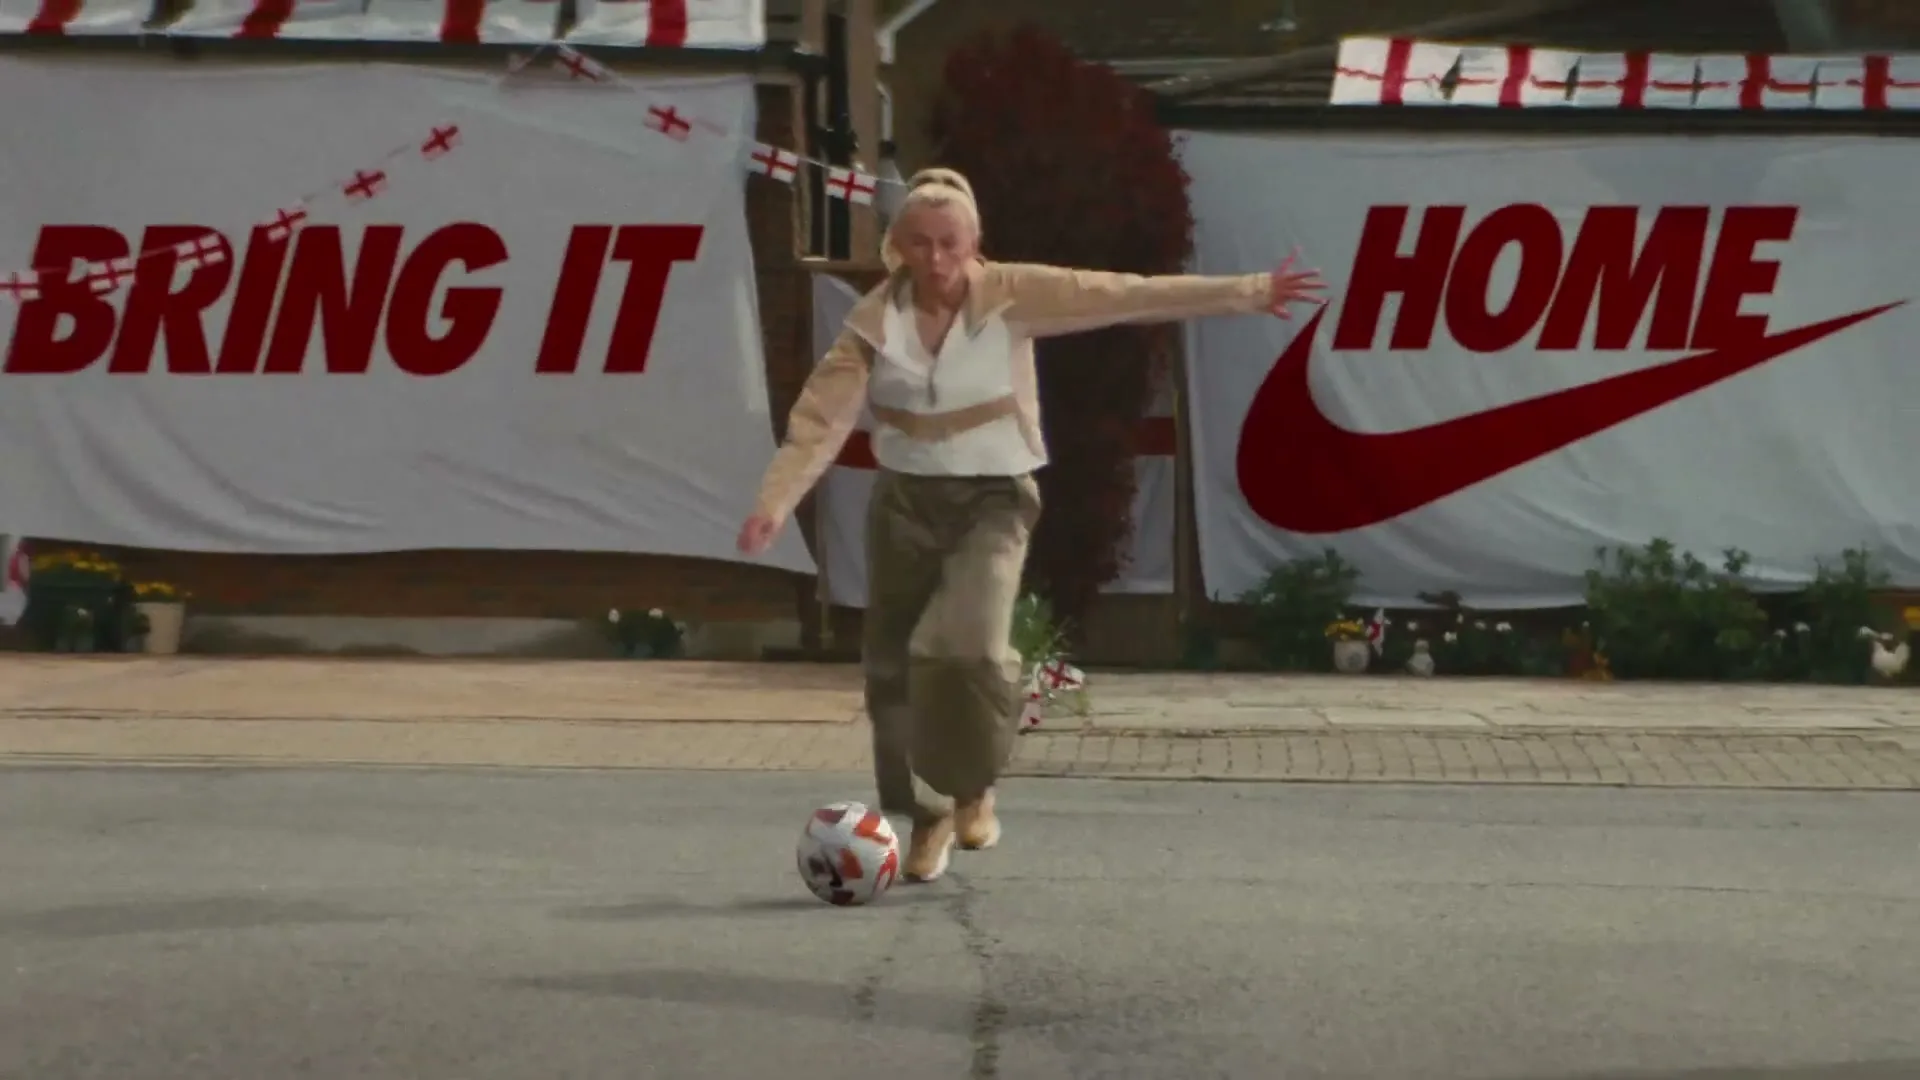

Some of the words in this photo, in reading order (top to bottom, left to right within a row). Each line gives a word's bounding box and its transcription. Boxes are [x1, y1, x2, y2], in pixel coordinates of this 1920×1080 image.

[3, 223, 509, 376] BRING
[535, 224, 704, 374] IT
[1331, 203, 1798, 353] HOME
